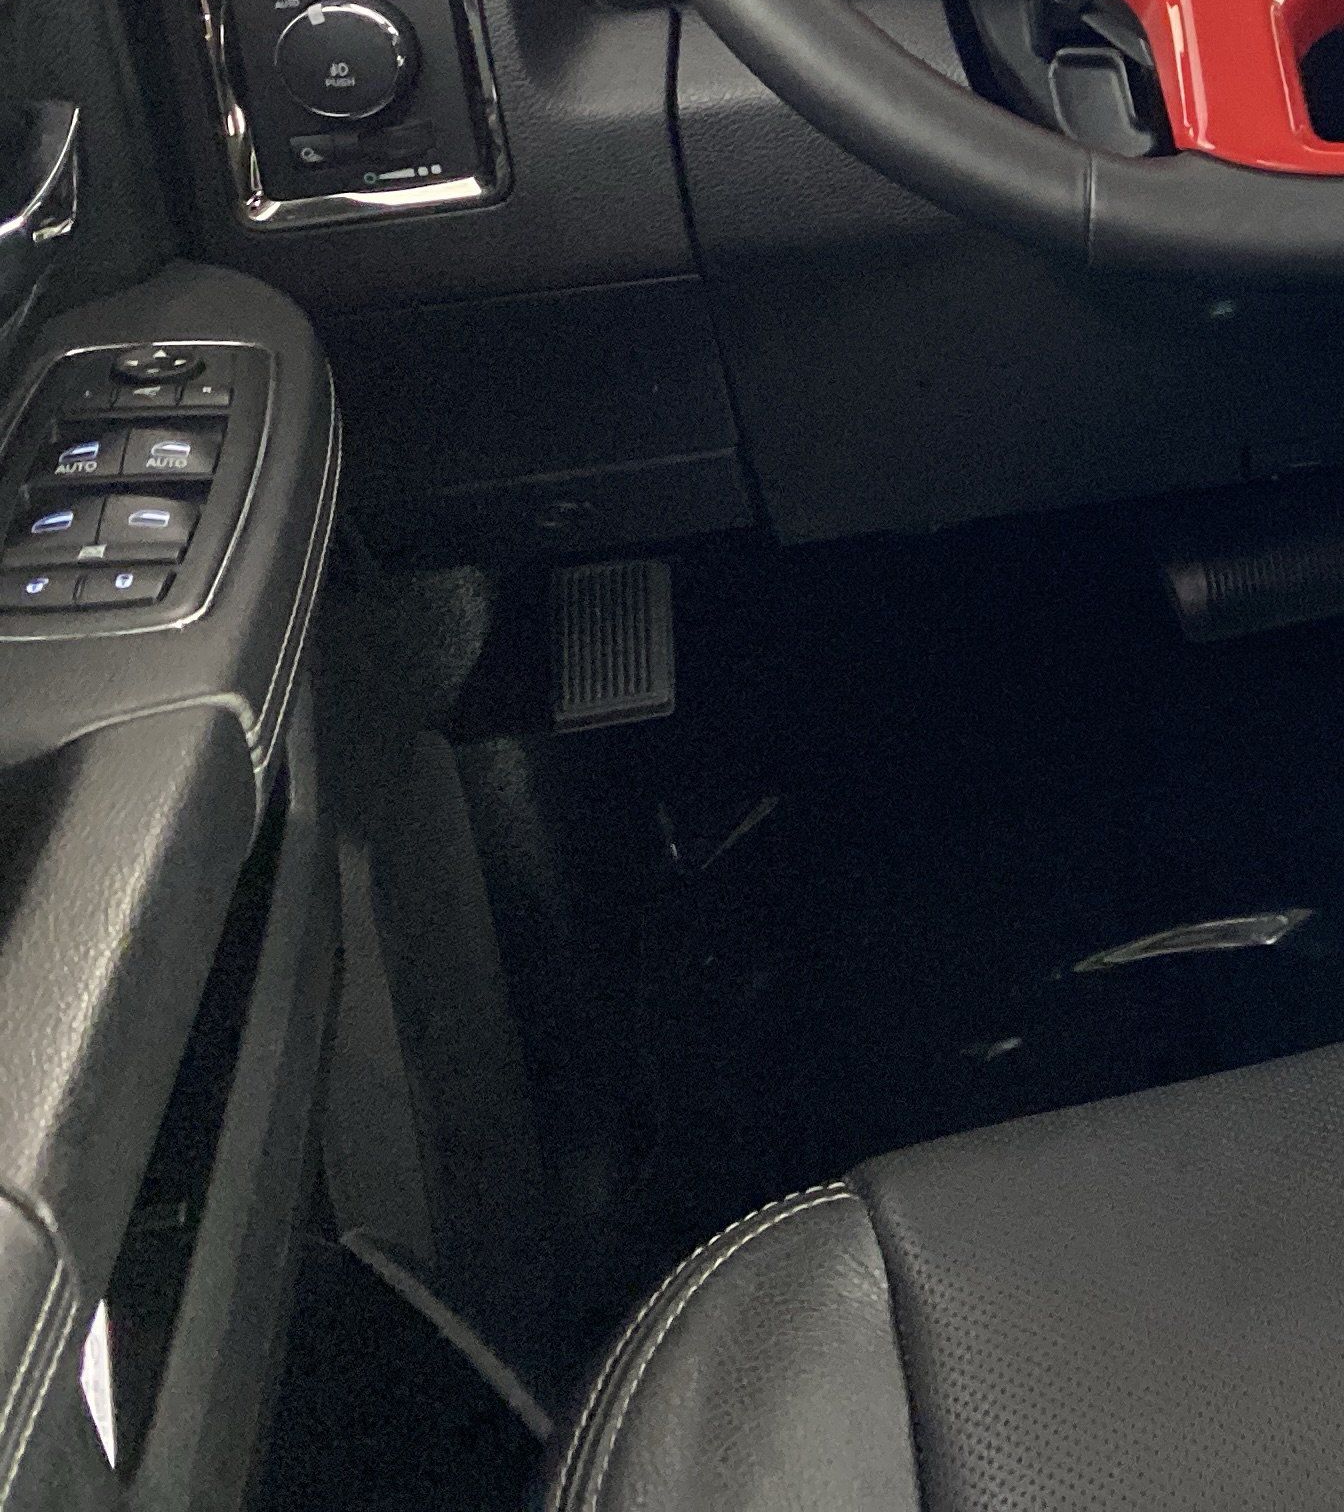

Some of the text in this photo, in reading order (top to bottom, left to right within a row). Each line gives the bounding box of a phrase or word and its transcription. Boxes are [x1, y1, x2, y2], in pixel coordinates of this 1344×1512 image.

[325, 78, 355, 87] PUSH
[55, 461, 98, 475] AUTO
[146, 458, 188, 469] AUTO
